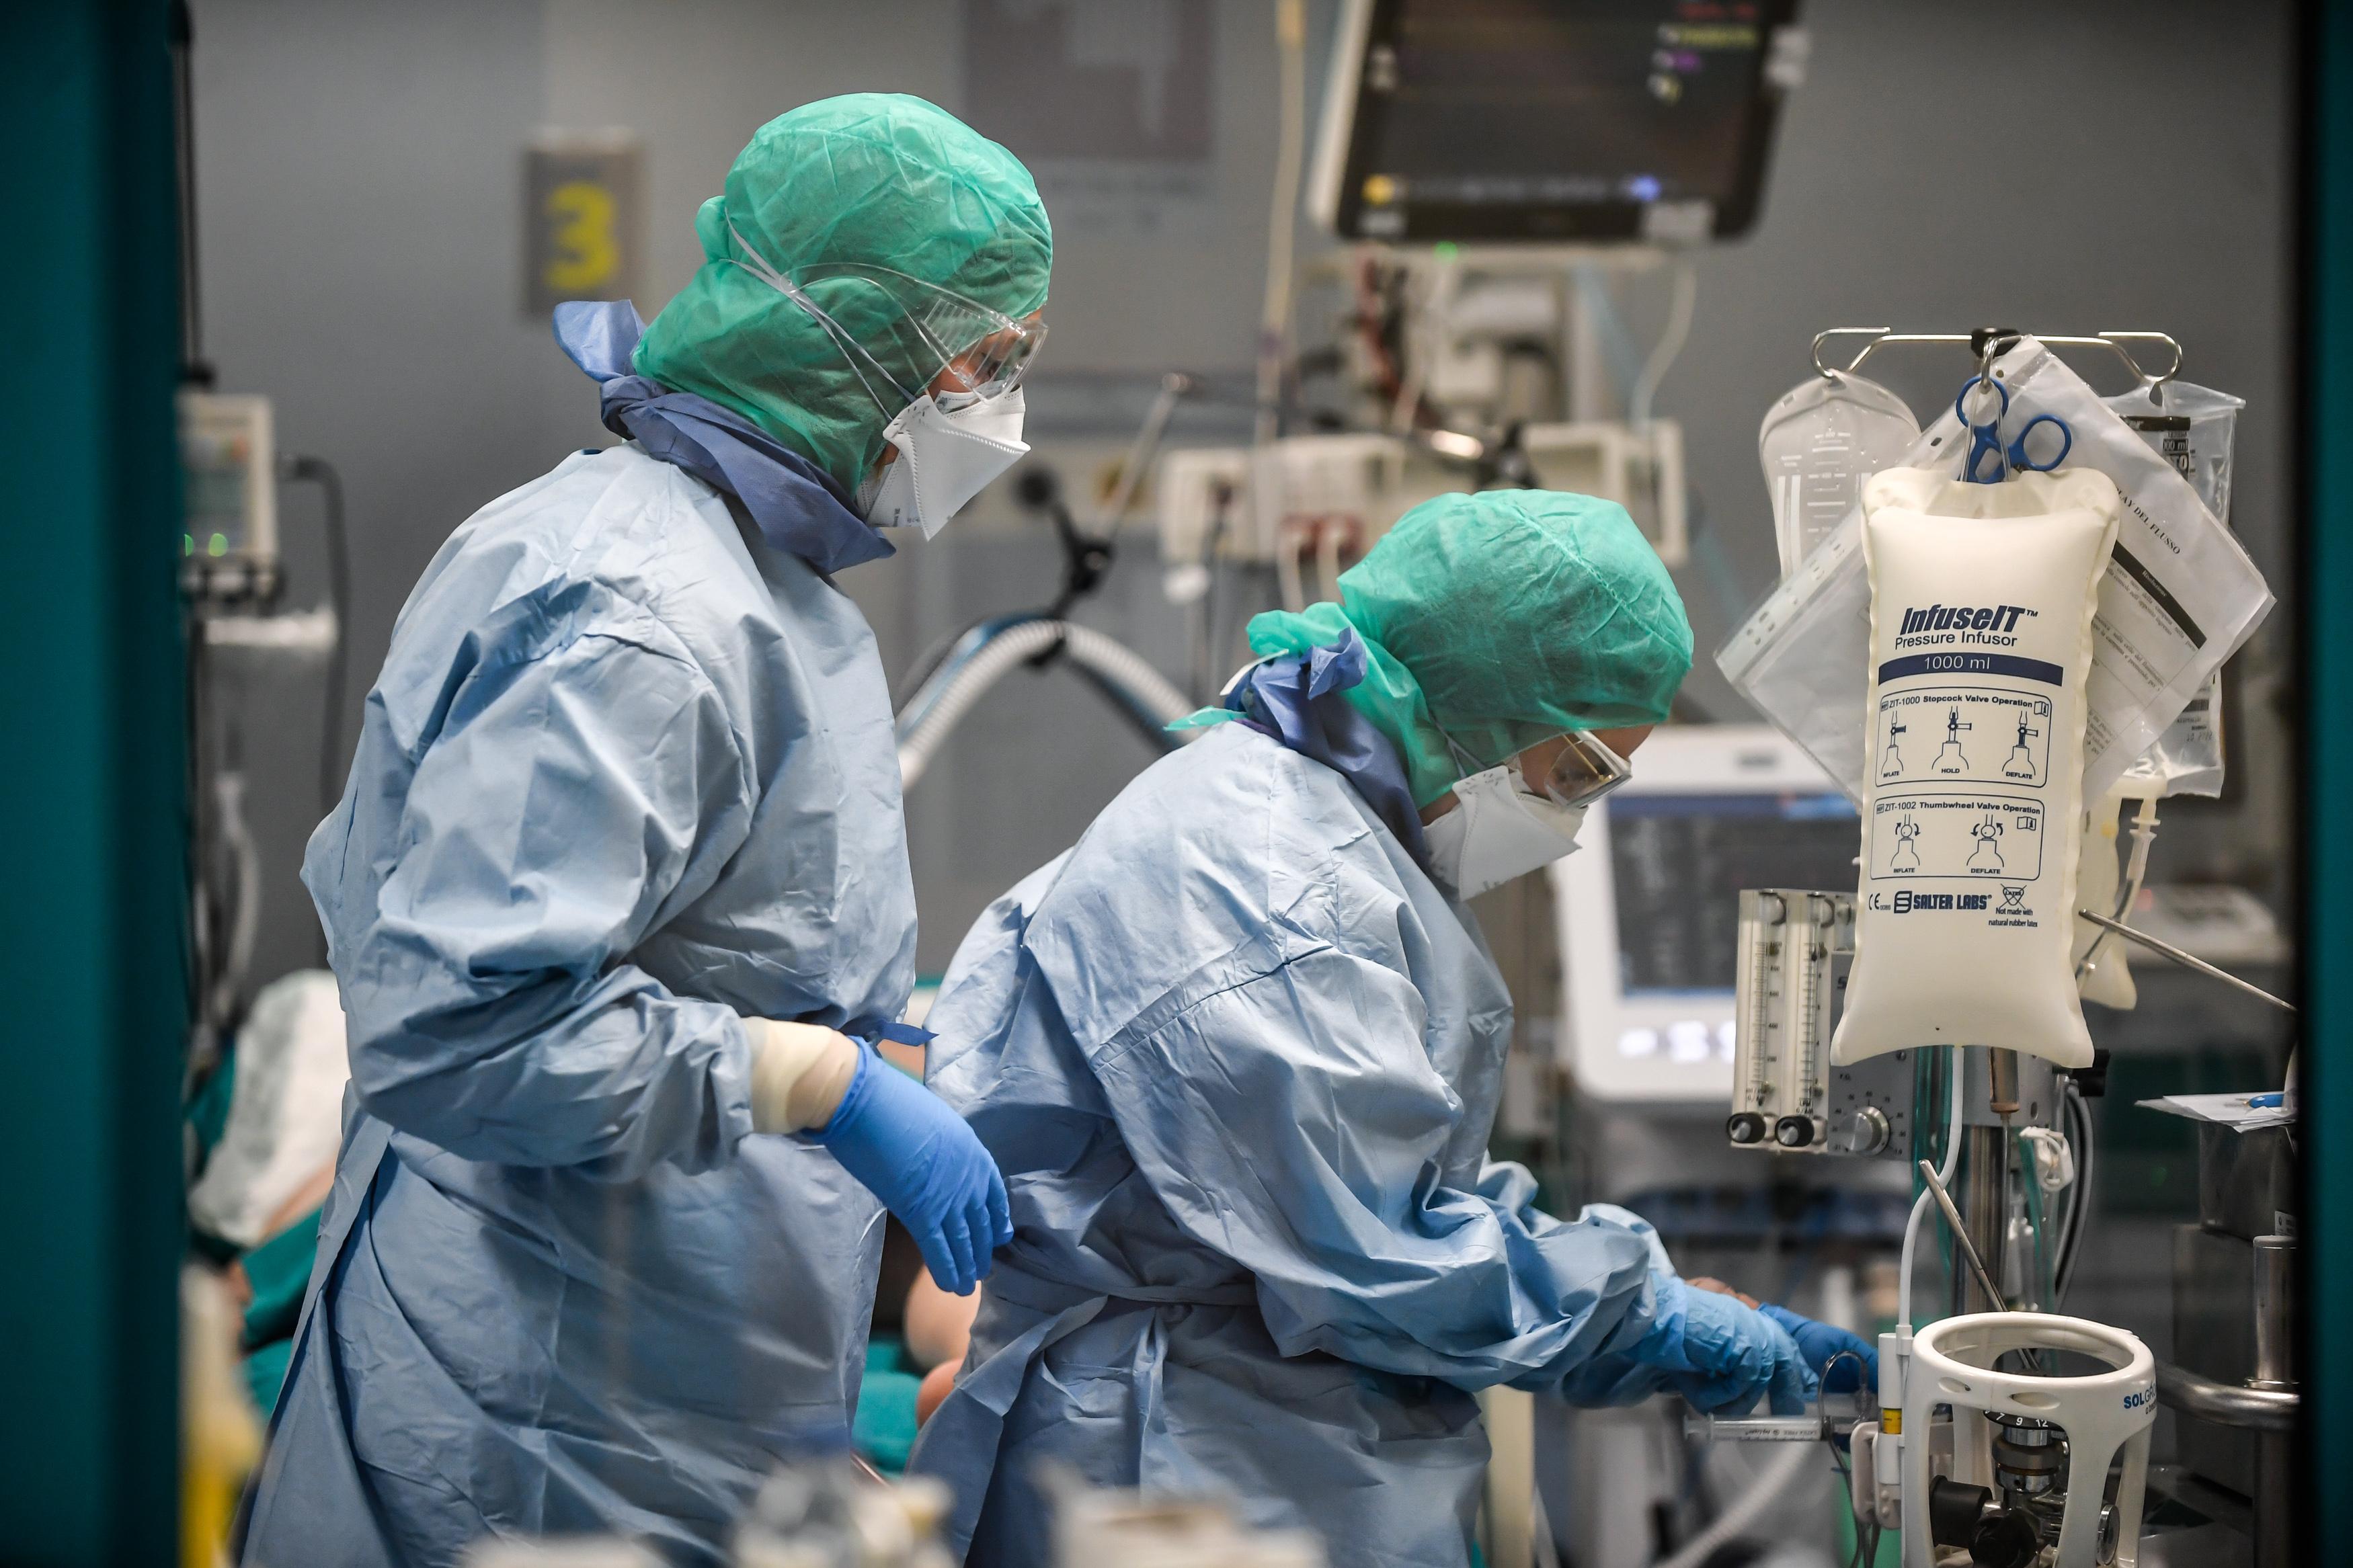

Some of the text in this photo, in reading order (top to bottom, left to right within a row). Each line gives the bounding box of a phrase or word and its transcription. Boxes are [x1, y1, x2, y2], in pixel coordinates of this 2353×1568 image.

[543, 179, 620, 296] 3
[2134, 507, 2149, 525] DEL
[2150, 524, 2180, 554] FLUSSO
[1895, 630, 2018, 650] Pressure Infusor
[1924, 655, 1990, 670] 1000 ml
[1889, 696, 1921, 708] ZIT-1000
[1923, 695, 1962, 703] Stopcock
[1992, 696, 2032, 708] Operation
[2005, 772, 2032, 780] DEFLATE
[1885, 802, 1916, 812] ZIT-1002
[2003, 804, 2040, 815] Operation
[1913, 894, 1953, 910] SALTER
[1988, 918, 2009, 926] natural
[1996, 1413, 2005, 1421] 7
[2016, 1417, 2023, 1426] 9
[2036, 1419, 2048, 1427] 12
